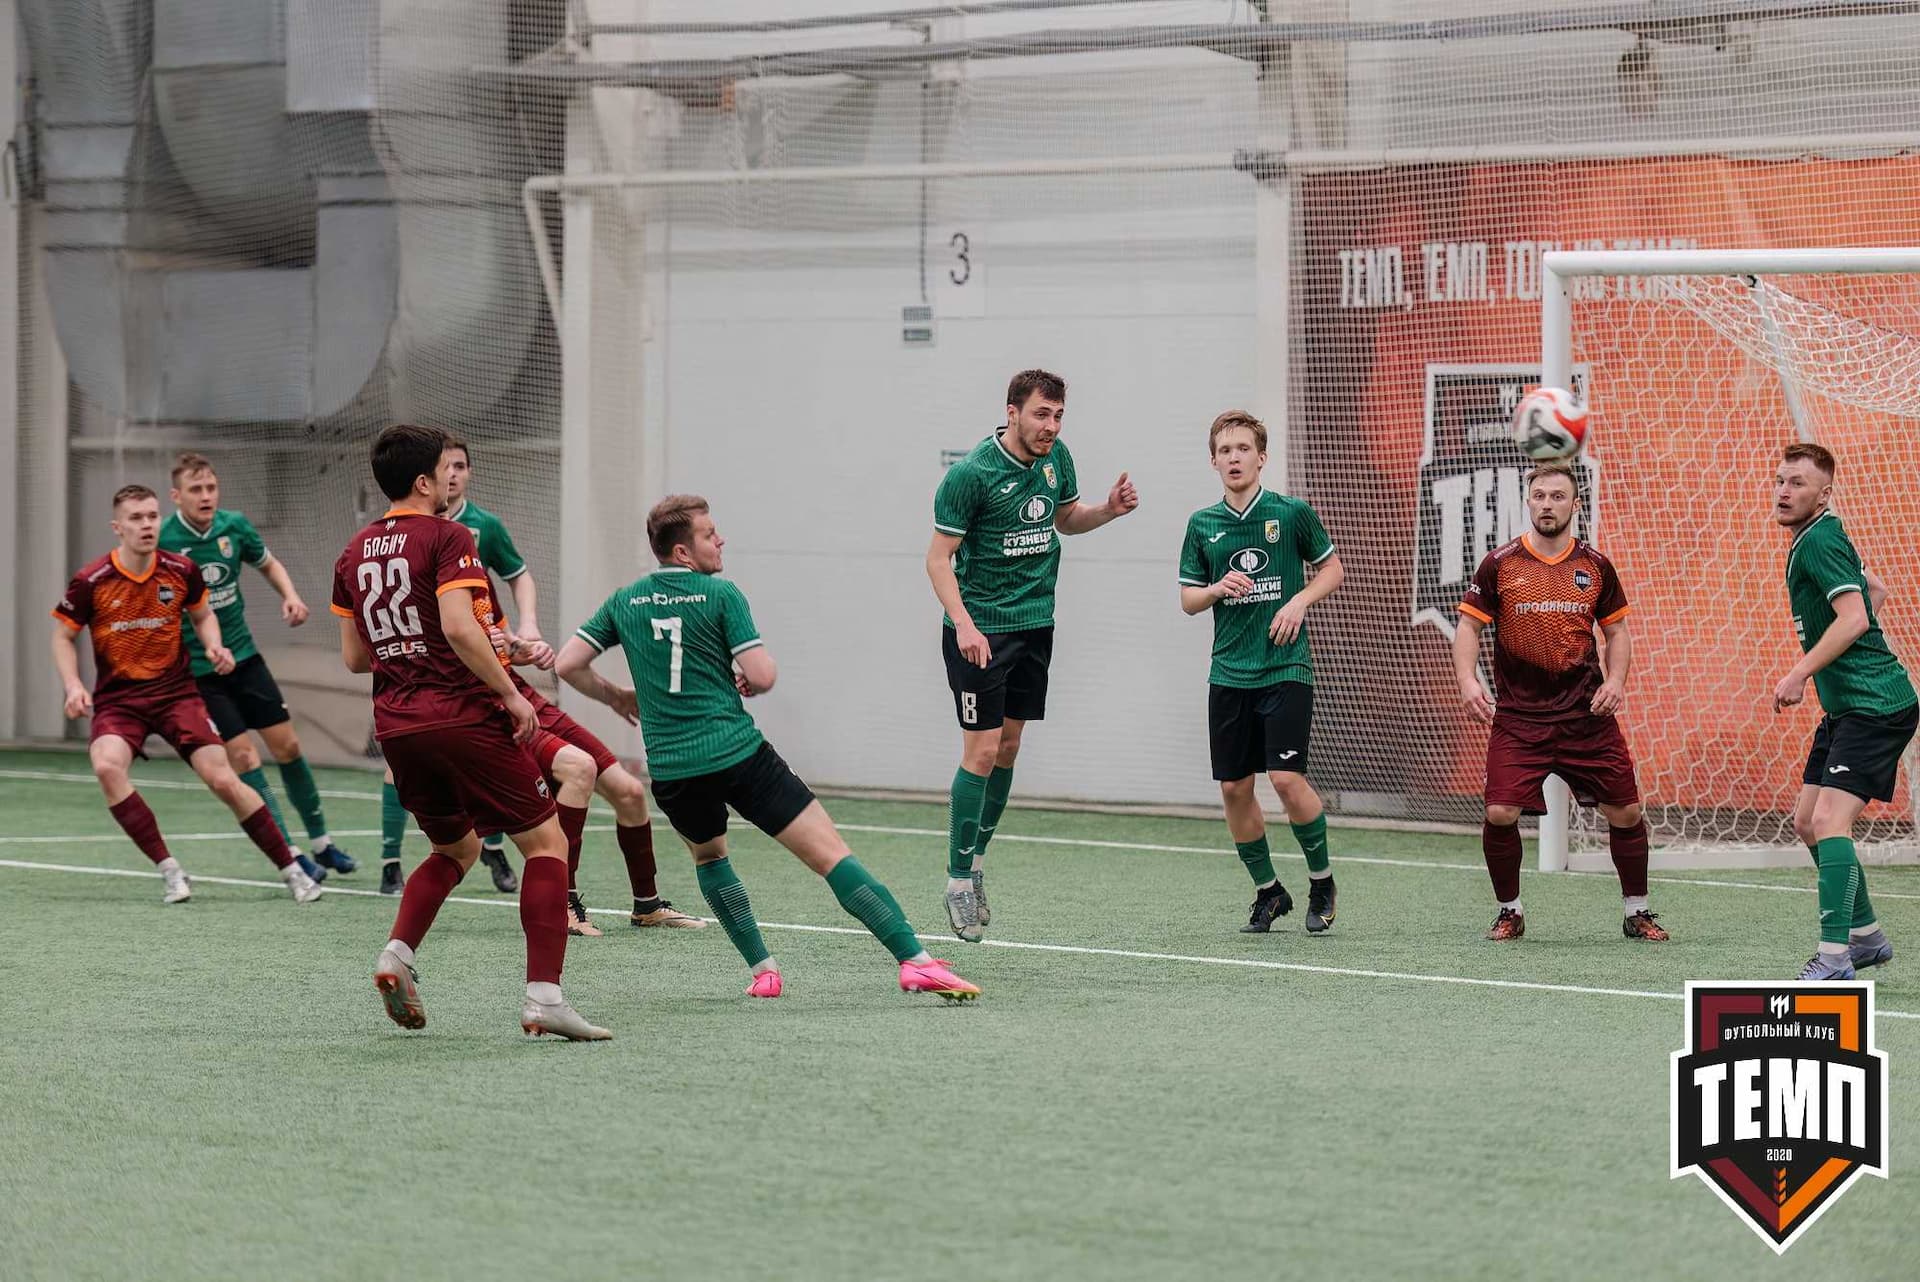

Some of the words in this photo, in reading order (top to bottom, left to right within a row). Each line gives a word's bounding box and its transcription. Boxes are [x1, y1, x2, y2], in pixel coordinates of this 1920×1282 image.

[949, 232, 970, 285] 3
[357, 557, 423, 643] 22
[651, 617, 683, 693] 7
[961, 691, 977, 724] 8
